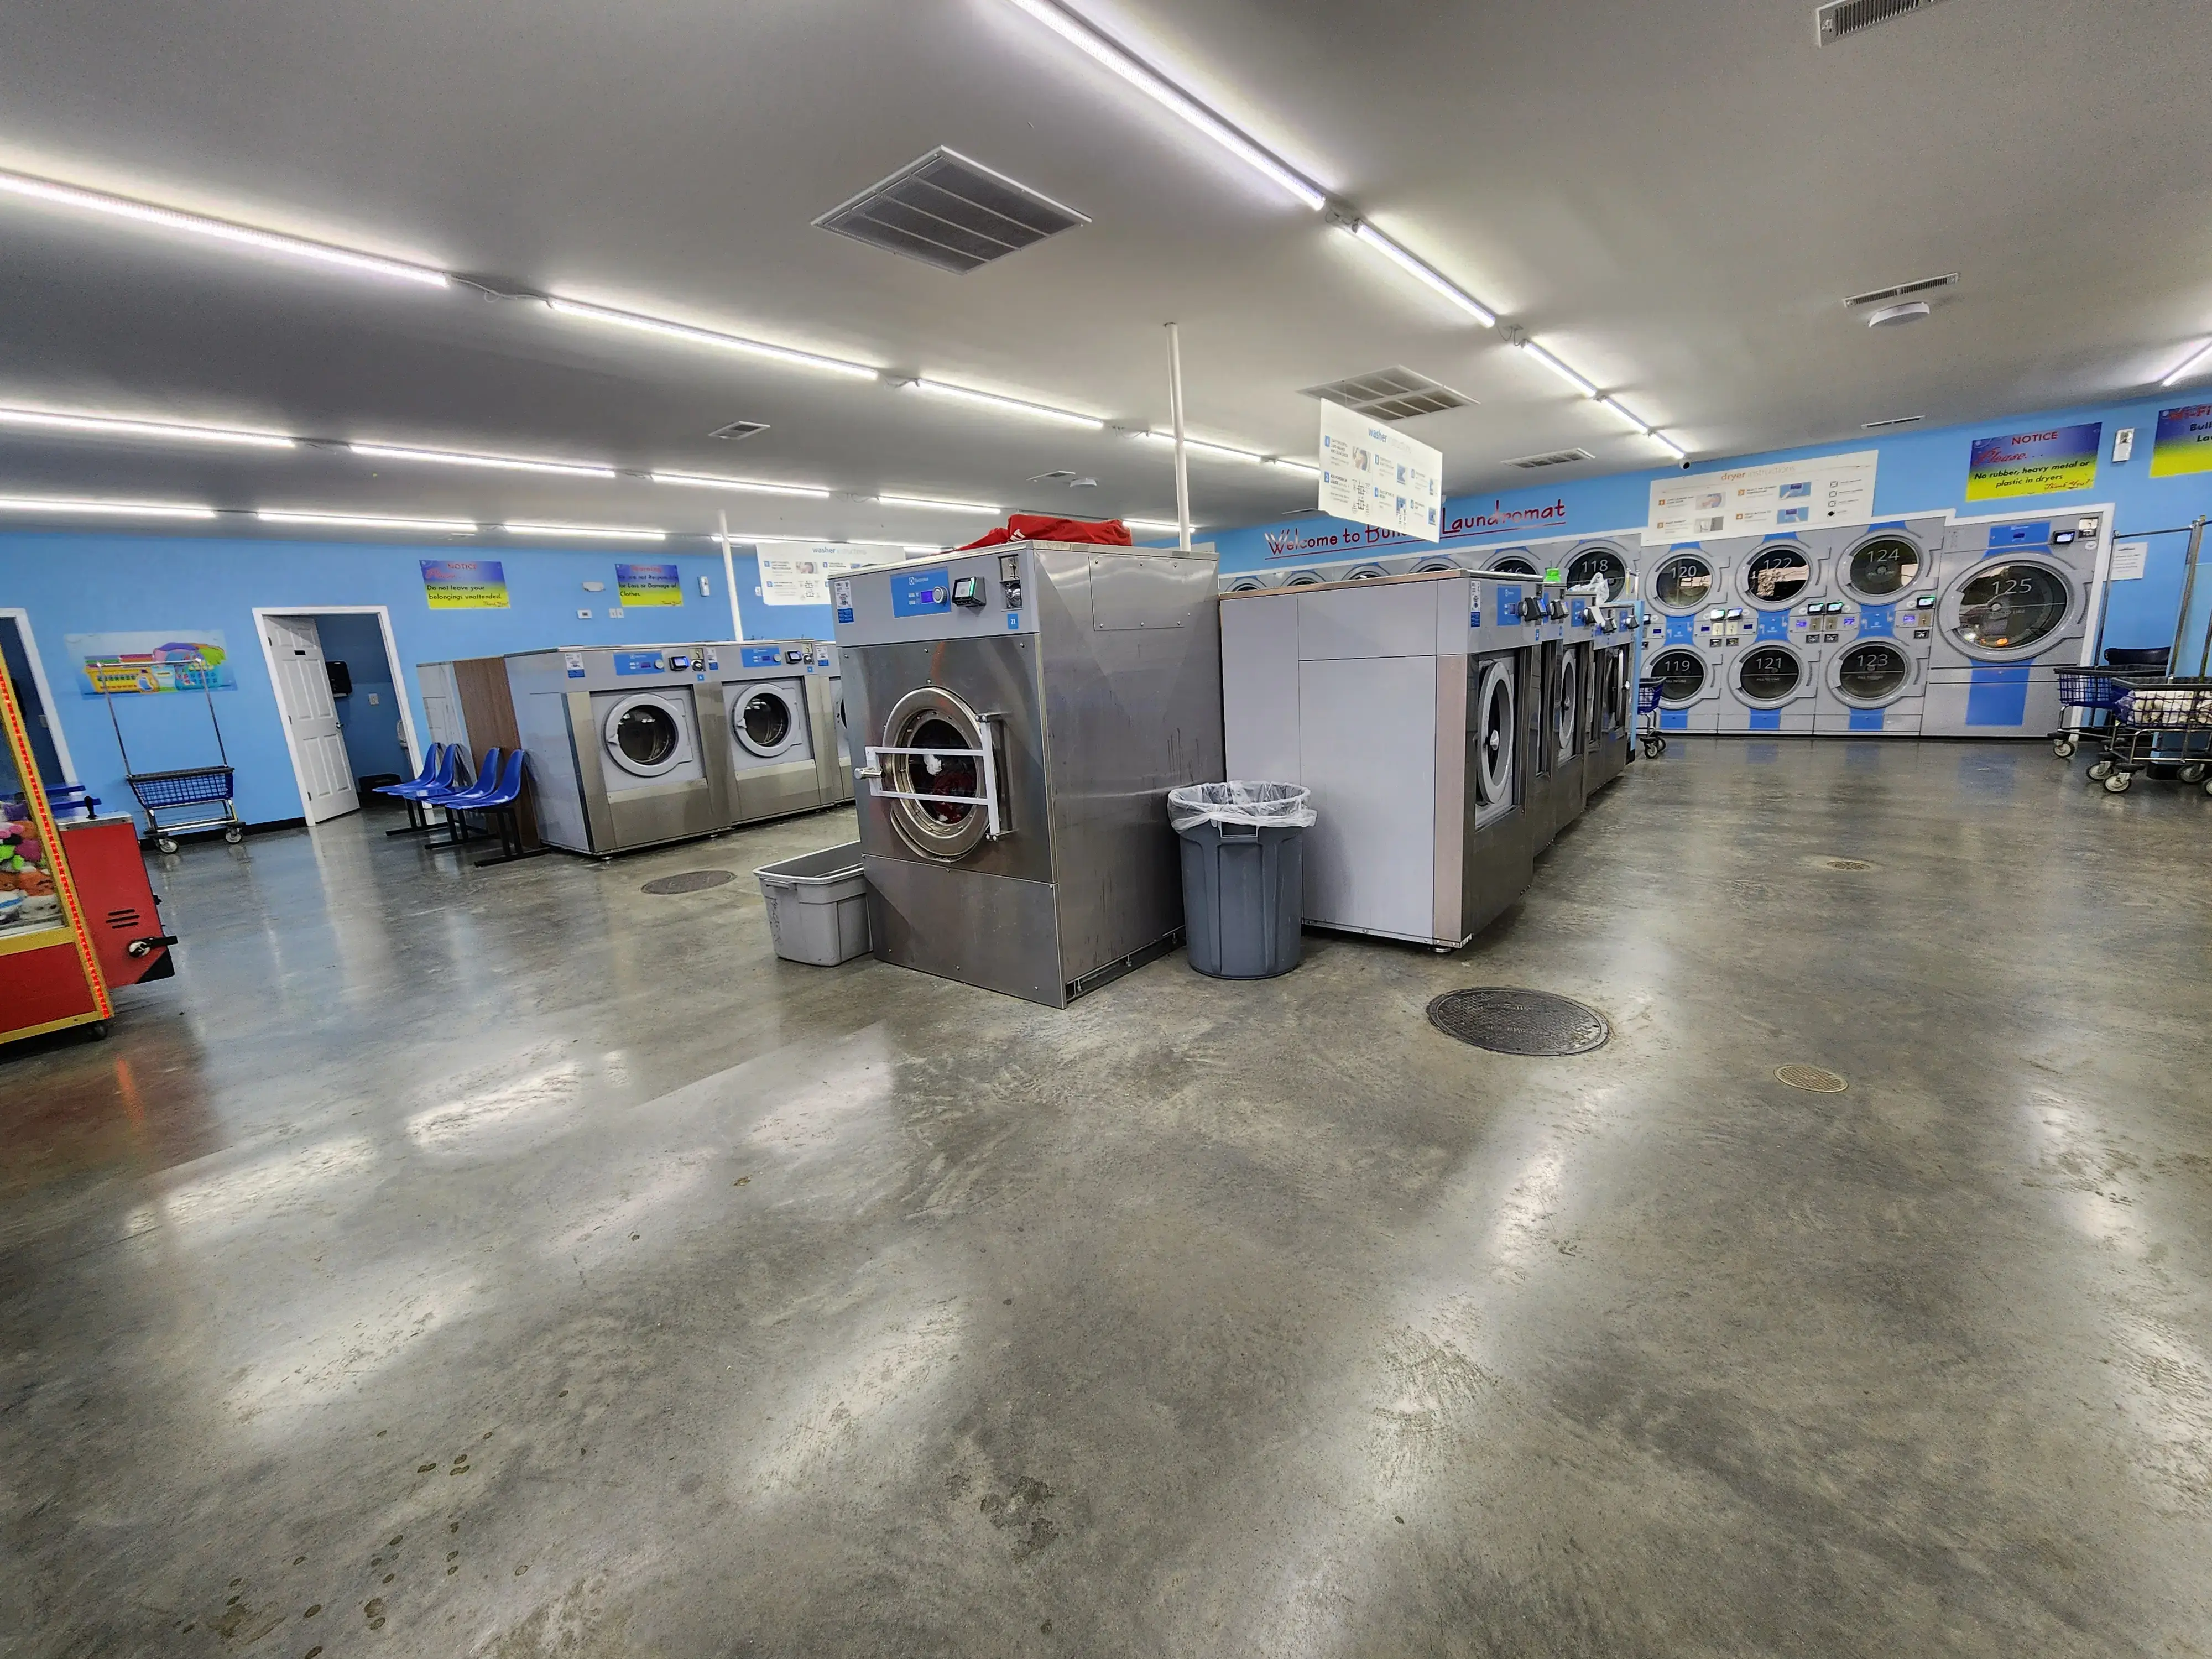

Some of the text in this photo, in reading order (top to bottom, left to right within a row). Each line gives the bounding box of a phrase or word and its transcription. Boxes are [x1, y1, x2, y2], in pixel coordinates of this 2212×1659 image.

[1368, 427, 1387, 443] washer
[2012, 431, 2058, 445] NOTICE
[1991, 469, 2020, 478] rubber,
[2022, 466, 2049, 476] heavy
[2052, 460, 2077, 470] metal
[1721, 473, 1746, 481] dryer
[1995, 478, 2023, 488] plastic
[2036, 474, 2064, 484] dryers
[1264, 528, 1338, 555] Welcome
[1342, 528, 1360, 544] to
[1442, 499, 1566, 534] Laundromat
[1867, 548, 1900, 562] 124
[1582, 559, 1609, 574] 118
[1764, 557, 1792, 571] 122
[1671, 565, 1697, 579] 120
[1991, 578, 2032, 595] 125
[1665, 660, 1691, 672] 119
[1756, 657, 1782, 670] 121
[1857, 654, 1888, 666] 123
